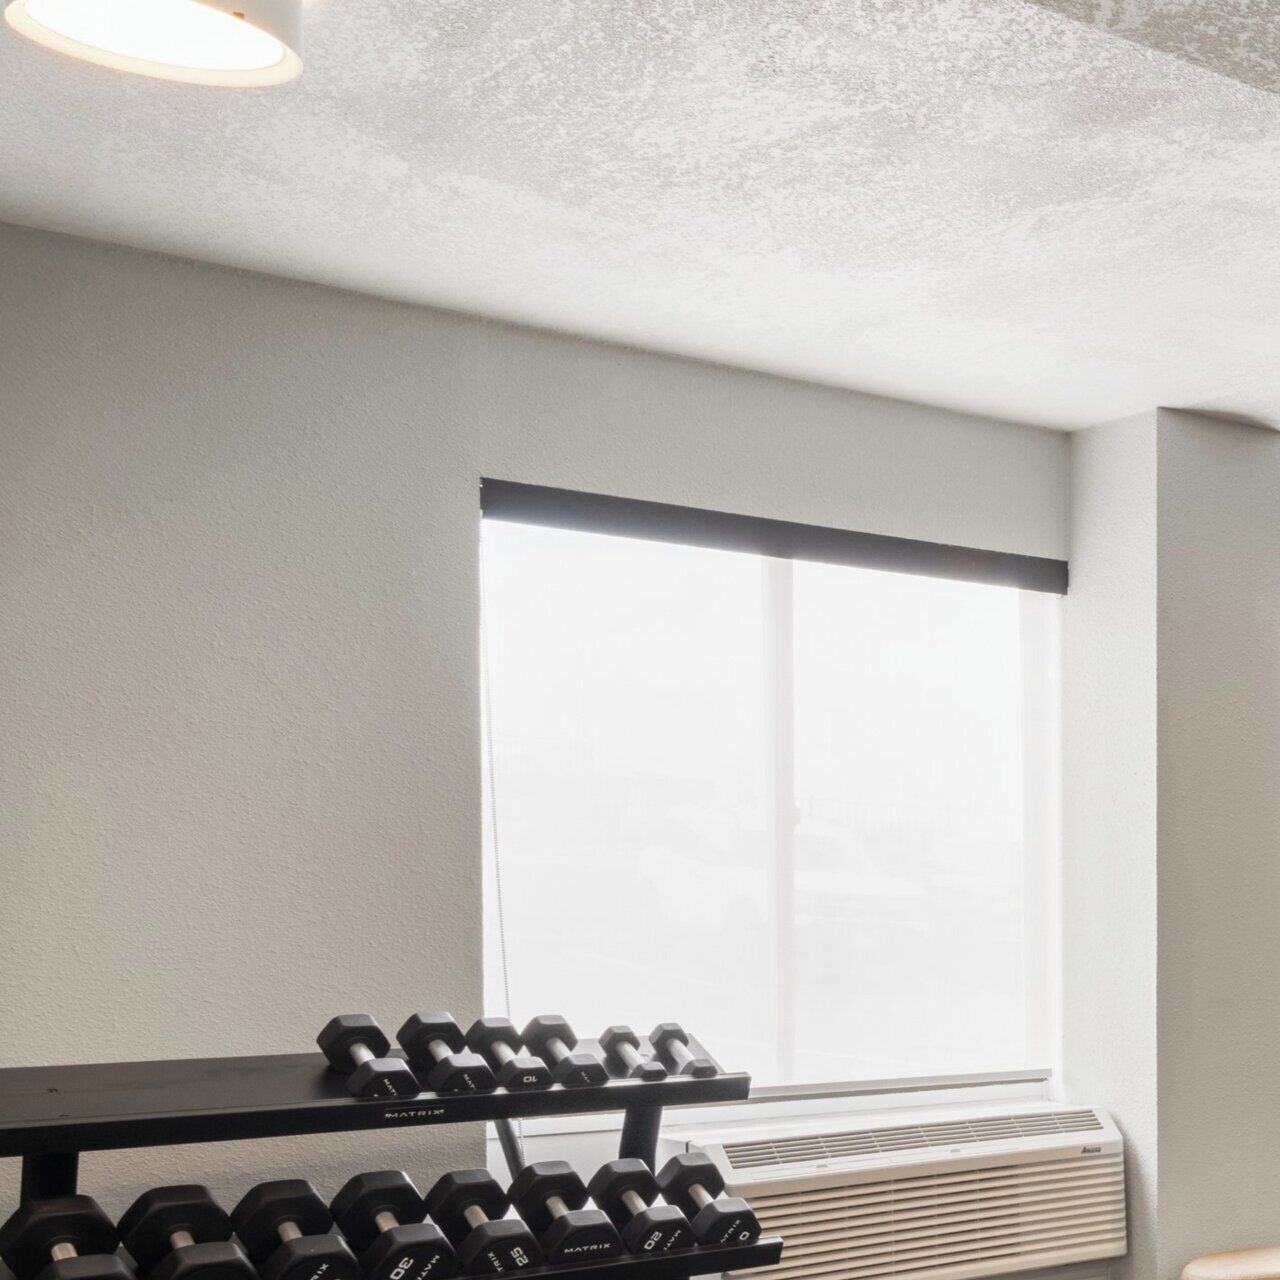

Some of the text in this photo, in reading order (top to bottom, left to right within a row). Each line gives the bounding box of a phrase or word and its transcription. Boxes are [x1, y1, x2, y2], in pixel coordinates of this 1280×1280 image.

[386, 1109, 443, 1118] MATRIX
[564, 1243, 611, 1254] MATRIX
[644, 1231, 662, 1250] 20
[510, 1246, 529, 1267] 25
[390, 1257, 414, 1280] 30
